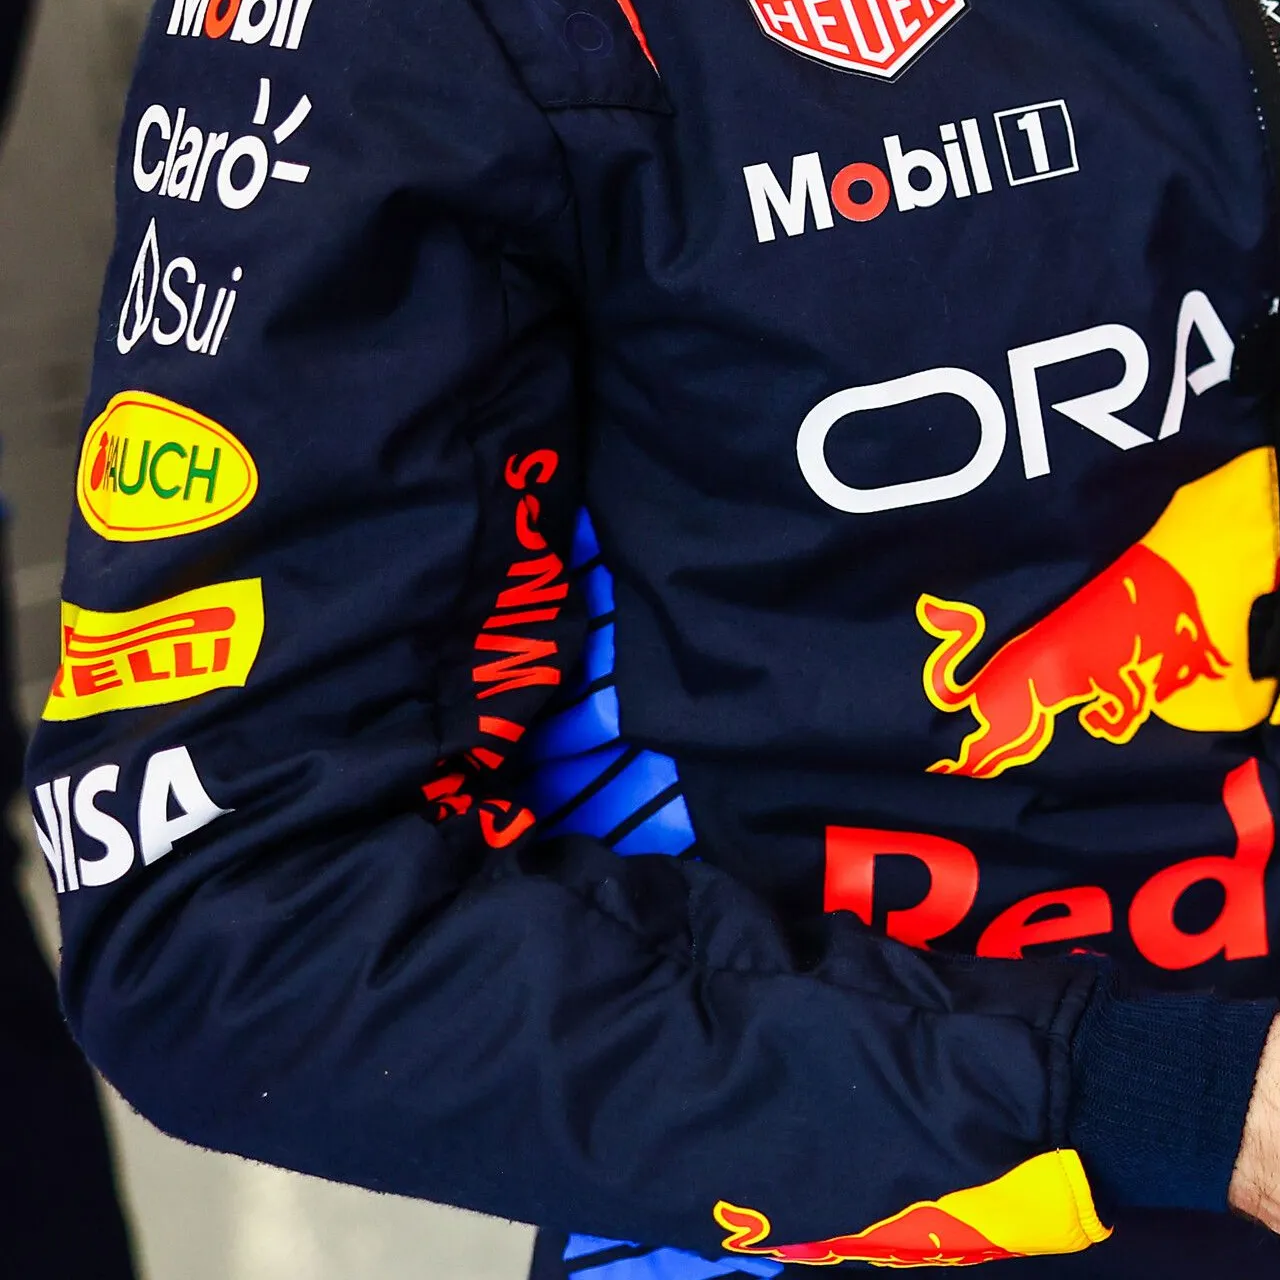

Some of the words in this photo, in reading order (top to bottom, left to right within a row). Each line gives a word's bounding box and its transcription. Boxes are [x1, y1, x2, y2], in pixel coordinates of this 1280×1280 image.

[132, 104, 269, 210] Claro
[742, 117, 993, 244] Mobil
[151, 256, 243, 356] Sui
[32, 745, 236, 894] VISA
